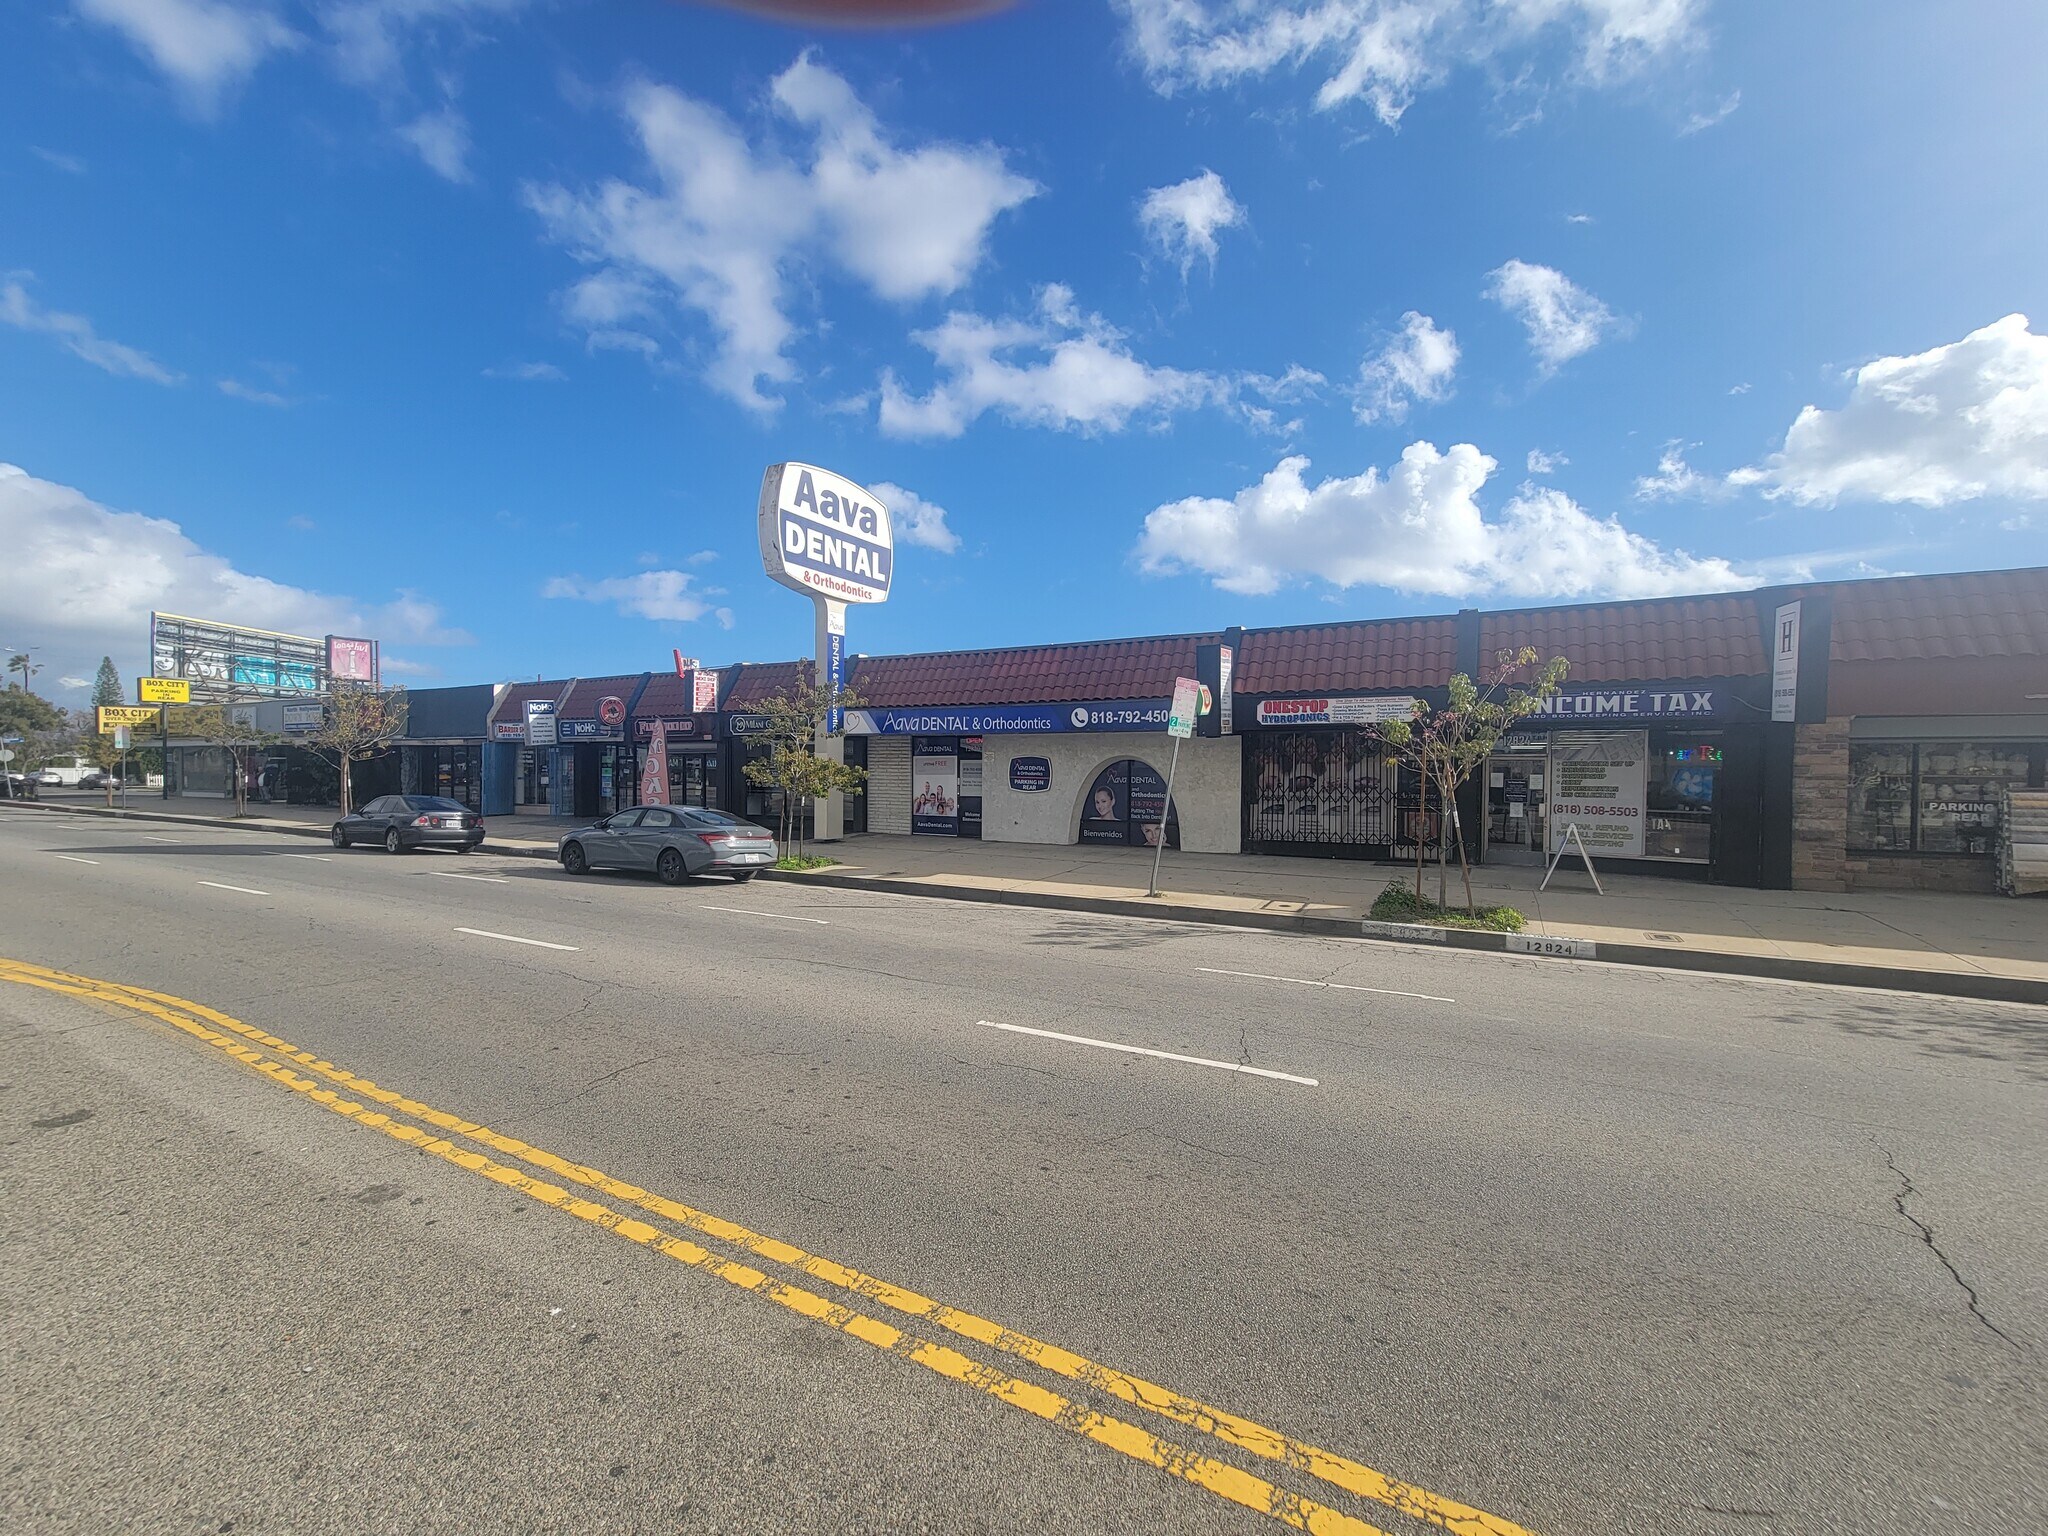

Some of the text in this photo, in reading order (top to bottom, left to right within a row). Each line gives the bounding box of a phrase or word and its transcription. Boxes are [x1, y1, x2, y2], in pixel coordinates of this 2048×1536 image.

[794, 470, 877, 537] Aava
[786, 520, 885, 582] DENTAL
[804, 571, 872, 600] & Orthodontics
[1782, 620, 1794, 653] H
[530, 703, 552, 713] NoHo
[1264, 700, 1328, 714] ONESTOP
[1535, 692, 1713, 714] NCOME TAX
[104, 708, 127, 717] BOX
[1091, 710, 1168, 724] 818-792-450
[1262, 713, 1329, 724] HYDROPONICS
[883, 712, 1050, 730] Aava DENTAL & Orthodontics
[574, 723, 596, 735] NoHo
[1504, 736, 1530, 746] 12824
[1107, 774, 1127, 784] Aava
[1553, 804, 1638, 817] (818) 508-5503
[1929, 802, 1994, 812] PARKING
[1951, 813, 1990, 822] REAR
[1084, 830, 1122, 838] Bienvenidos
[1526, 941, 1572, 956] 12824
